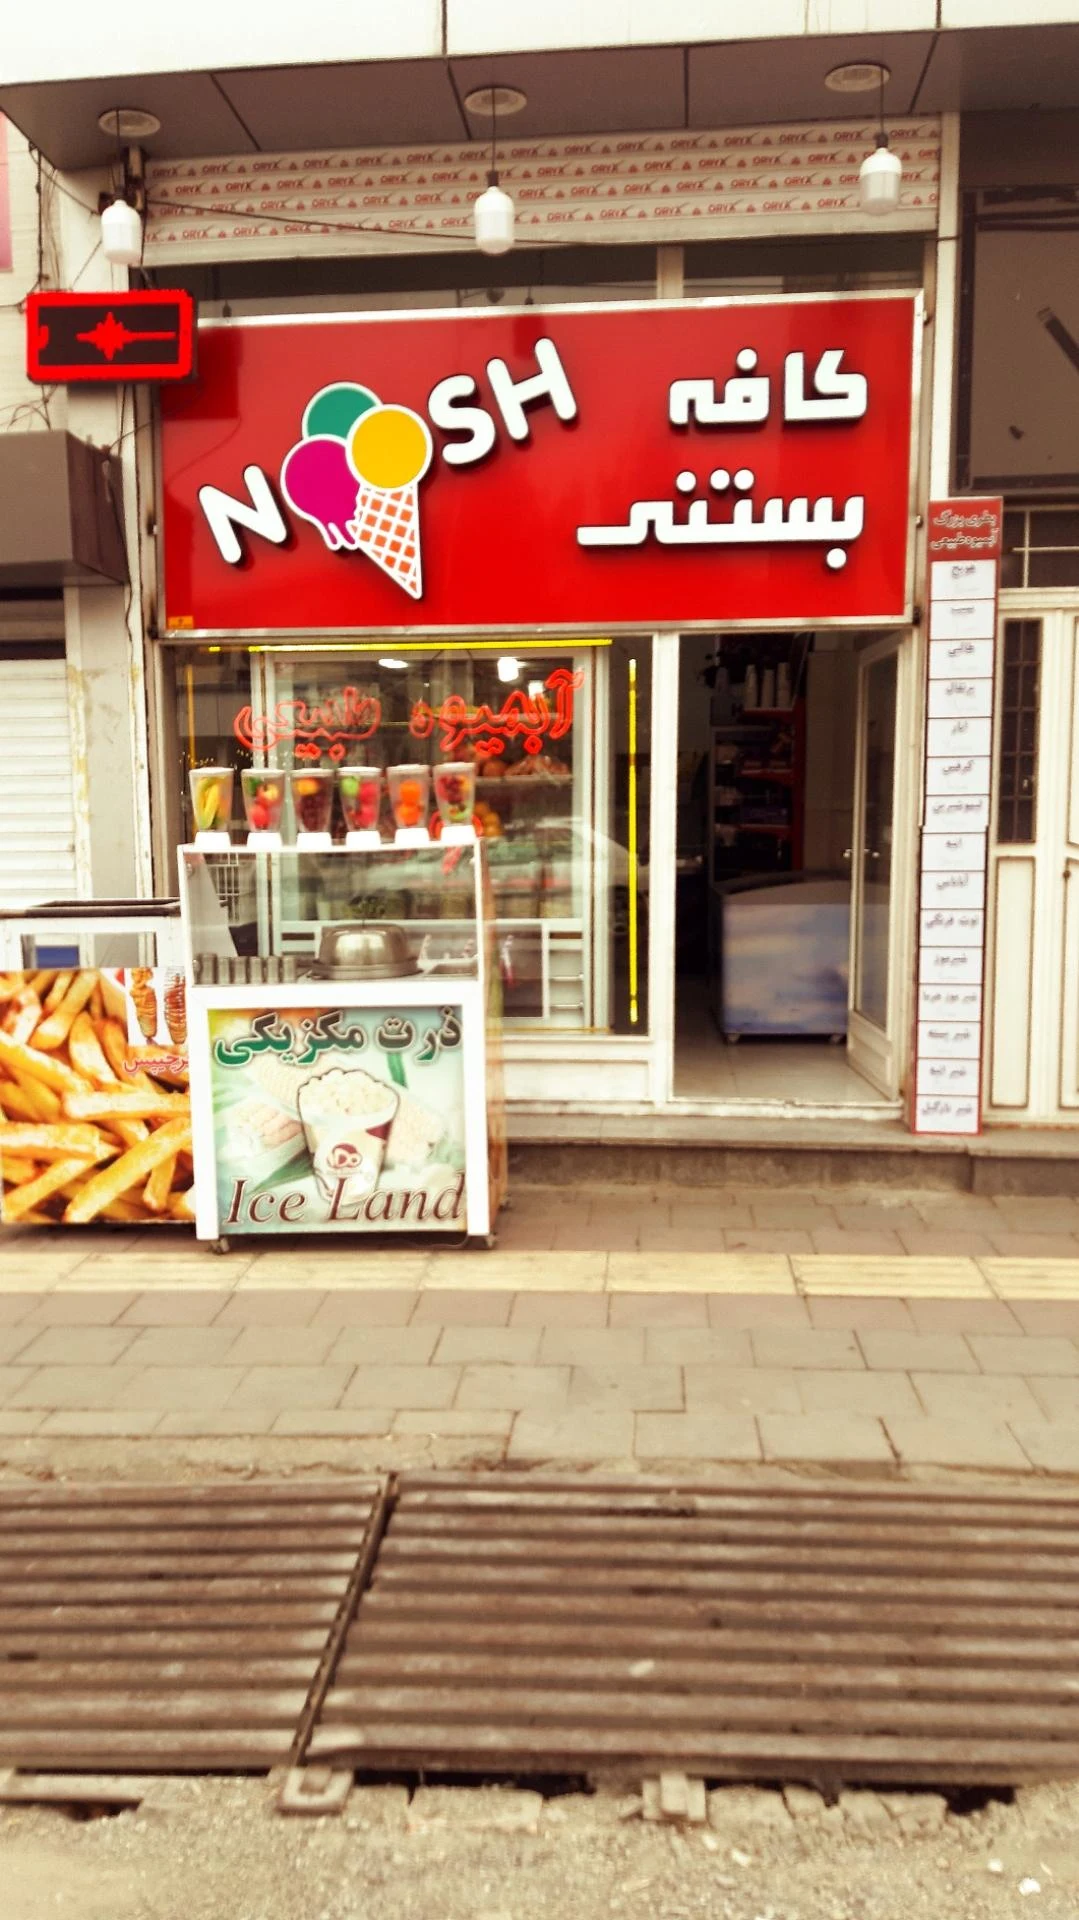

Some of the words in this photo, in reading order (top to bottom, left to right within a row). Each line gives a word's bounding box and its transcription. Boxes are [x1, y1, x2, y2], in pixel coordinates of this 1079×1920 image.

[153, 164, 181, 178] ORYX
[202, 162, 232, 174] ORYX
[253, 159, 282, 171] ORYX
[304, 157, 333, 169] ORYX
[356, 153, 385, 165] ORYX
[407, 151, 437, 163] ORYX
[459, 148, 489, 161] ORYX
[512, 146, 541, 158] ORYX
[565, 142, 594, 154] ORYX
[617, 139, 647, 152] ORYX
[671, 137, 702, 149] ORYX
[724, 133, 756, 146] ORYX
[780, 131, 810, 144] ORYX
[834, 128, 866, 142] ORYX
[890, 126, 921, 139] ORYX
[176, 182, 204, 195] ORYX
[226, 179, 254, 193] ORYX
[278, 176, 307, 190] ORYX
[328, 174, 358, 187] ORYX
[381, 172, 410, 184] ORYX
[433, 169, 462, 181] ORYX
[538, 164, 568, 177] ORYX
[591, 161, 622, 174] ORYX
[645, 159, 675, 171] ORYX
[699, 156, 730, 168] ORYX
[753, 154, 784, 166] ORYX
[808, 151, 839, 164] ORYX
[261, 197, 290, 209] ORYX
[312, 195, 341, 208] ORYX
[363, 193, 392, 206] ORYX
[415, 191, 444, 203] ORYX
[519, 186, 549, 198] ORYX
[571, 184, 601, 197] ORYX
[624, 182, 654, 195] ORYX
[676, 180, 708, 191] ORYX
[731, 177, 761, 189] ORYX
[784, 173, 816, 186] ORYX
[183, 227, 211, 240] ORYX
[234, 224, 263, 237] ORYX
[389, 217, 419, 229] ORYX
[441, 215, 471, 227] ORYX
[547, 210, 578, 223] ORYX
[601, 207, 631, 219] ORYX
[654, 205, 685, 216] ORYX
[708, 201, 739, 214] ORYX
[763, 199, 795, 210] ORYX
[818, 196, 850, 208] ORYX
[669, 348, 867, 425] کافه
[577, 468, 864, 569] بستنی
[215, 1008, 366, 1066] مکزیکی
[376, 1006, 461, 1061] ذرت
[223, 1176, 306, 1224] Ice
[327, 1171, 466, 1224] Land
